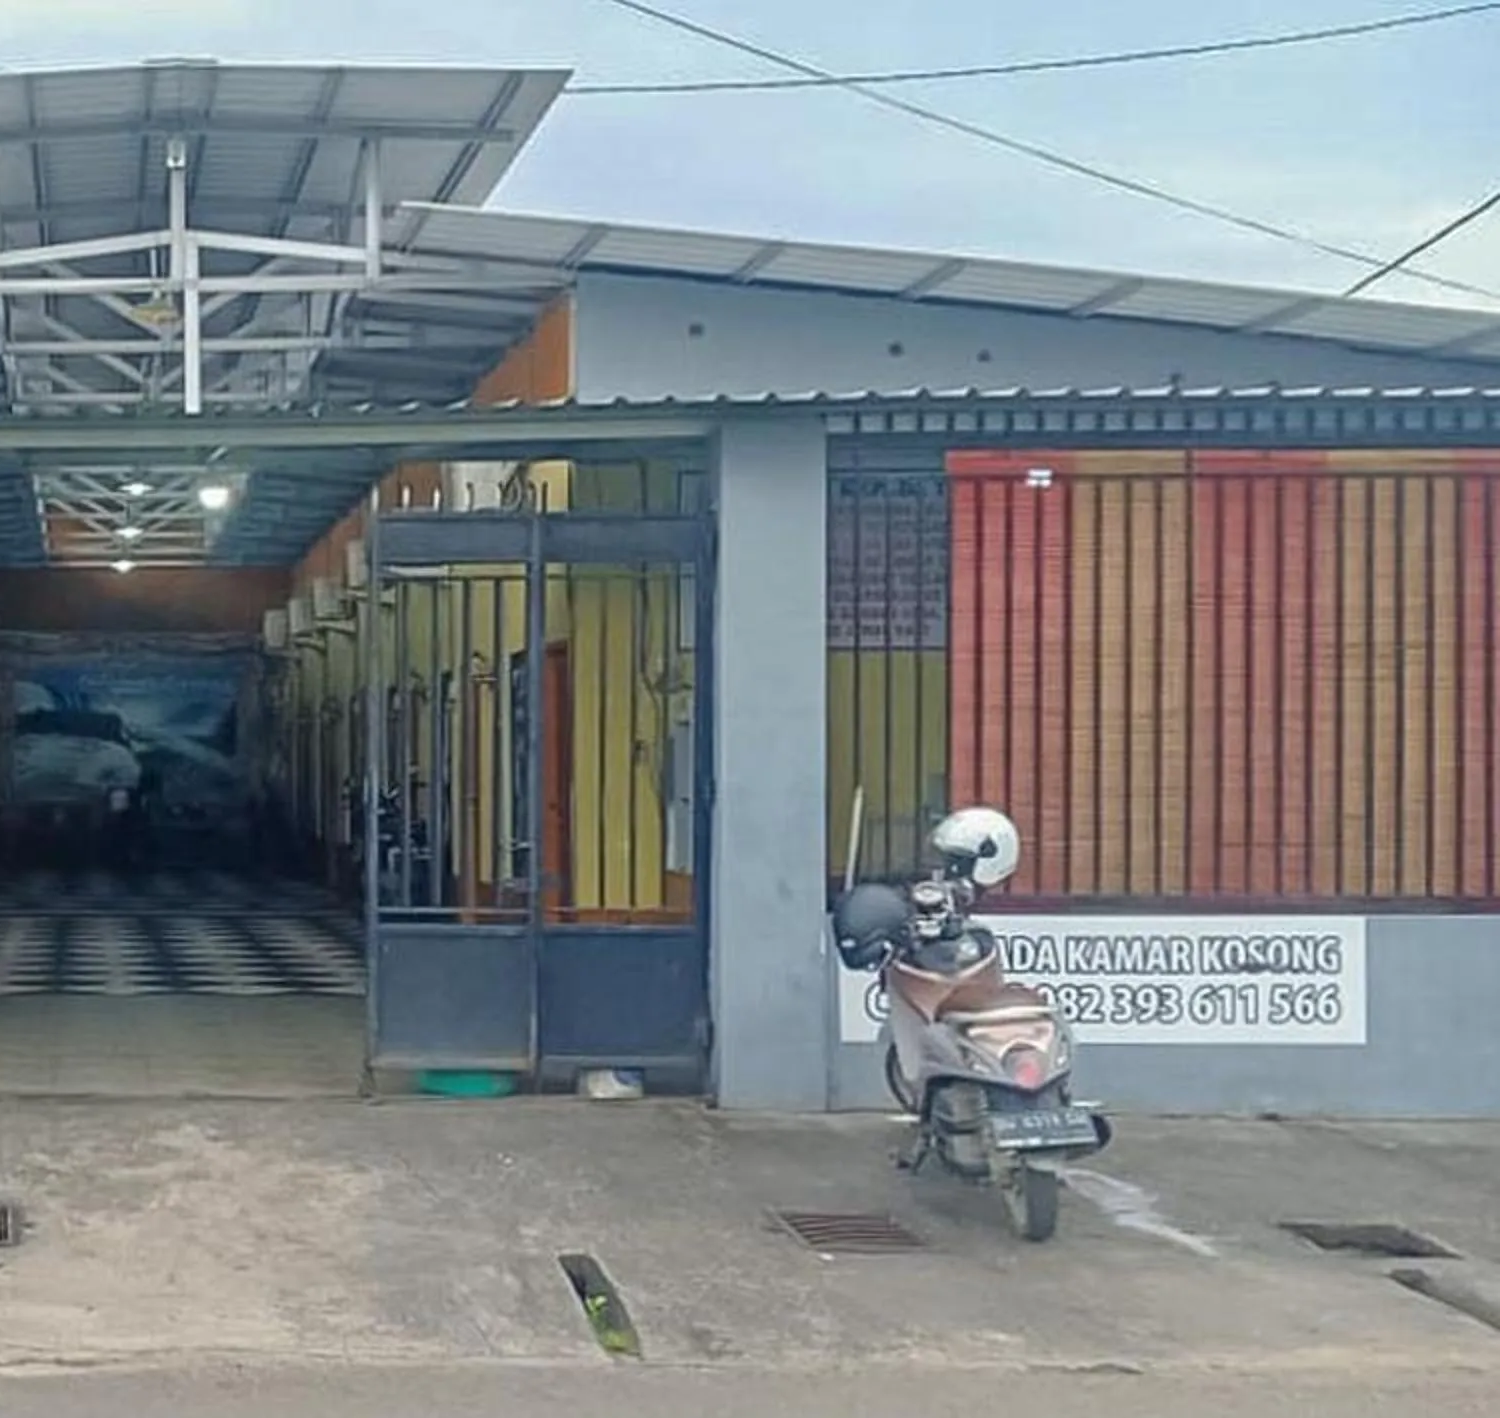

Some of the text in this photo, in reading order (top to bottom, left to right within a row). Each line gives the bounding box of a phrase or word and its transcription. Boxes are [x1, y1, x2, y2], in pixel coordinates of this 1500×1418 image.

[1065, 935, 1194, 974] KAMAR
[1201, 935, 1342, 974] KOSONG
[1109, 984, 1185, 1024] 393
[1190, 984, 1258, 1024] 611
[1272, 984, 1342, 1024] 566
